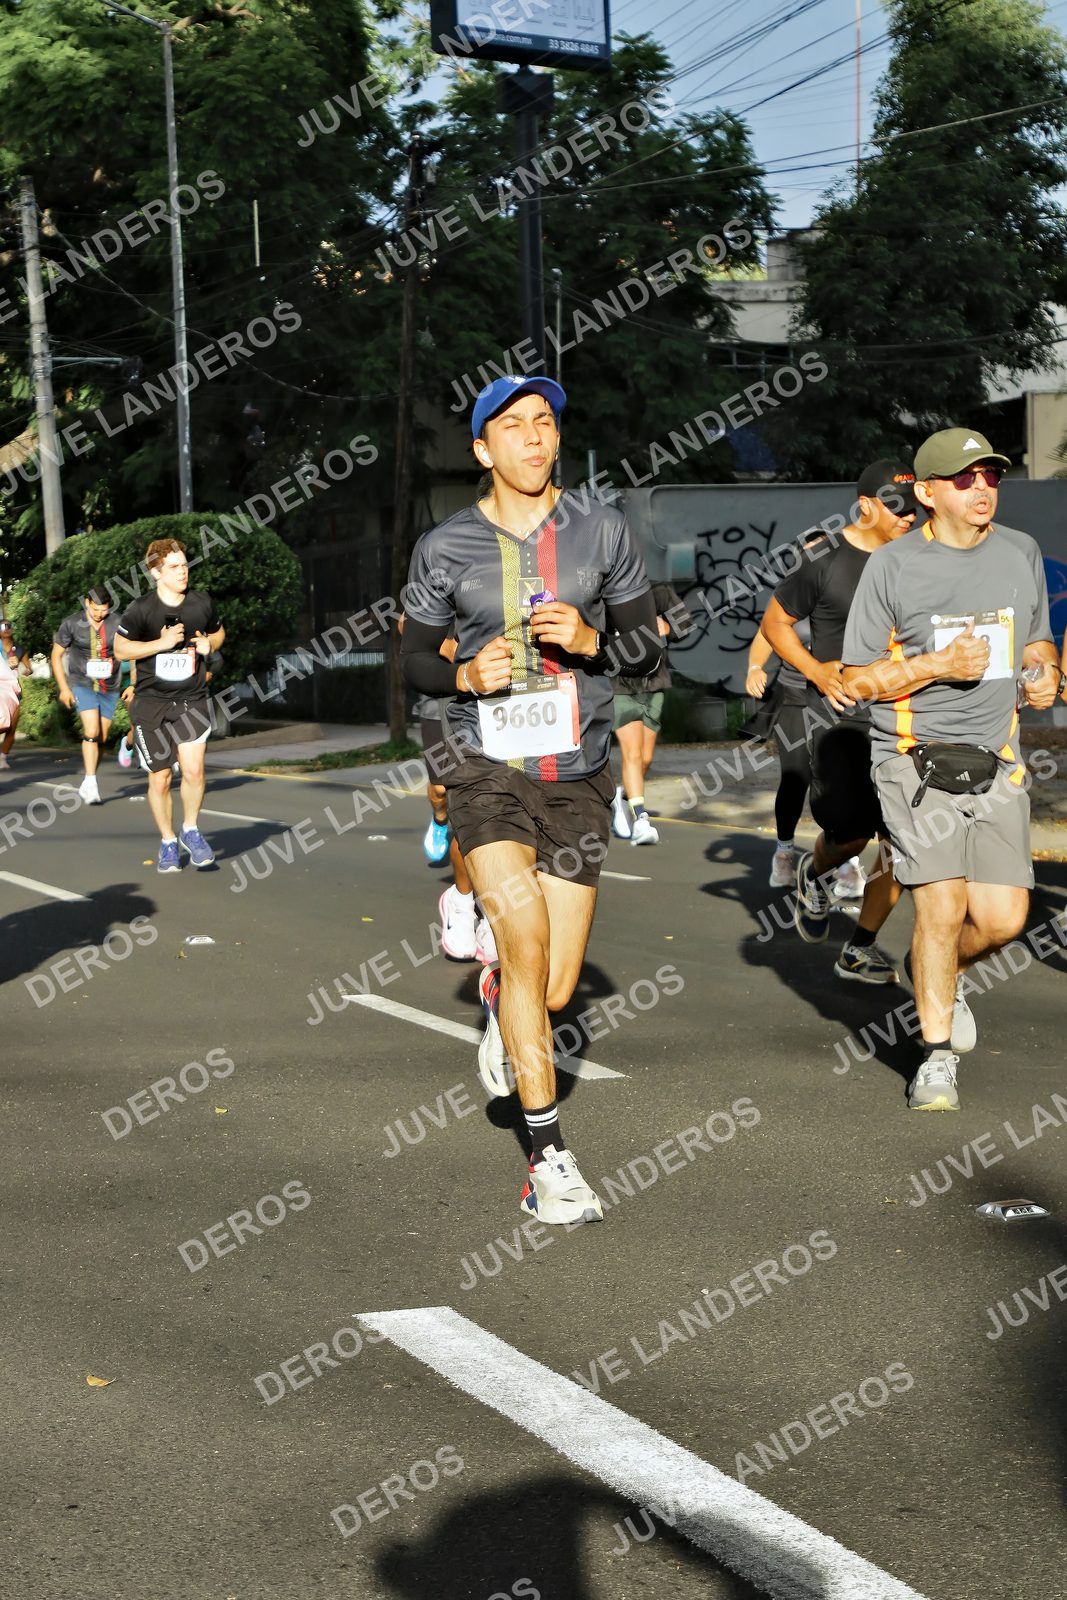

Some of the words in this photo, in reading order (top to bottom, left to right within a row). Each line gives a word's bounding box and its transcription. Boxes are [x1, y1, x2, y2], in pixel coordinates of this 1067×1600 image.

[697, 521, 777, 553] TOY
[163, 658, 187, 668] 9717
[492, 701, 558, 731] 9660
